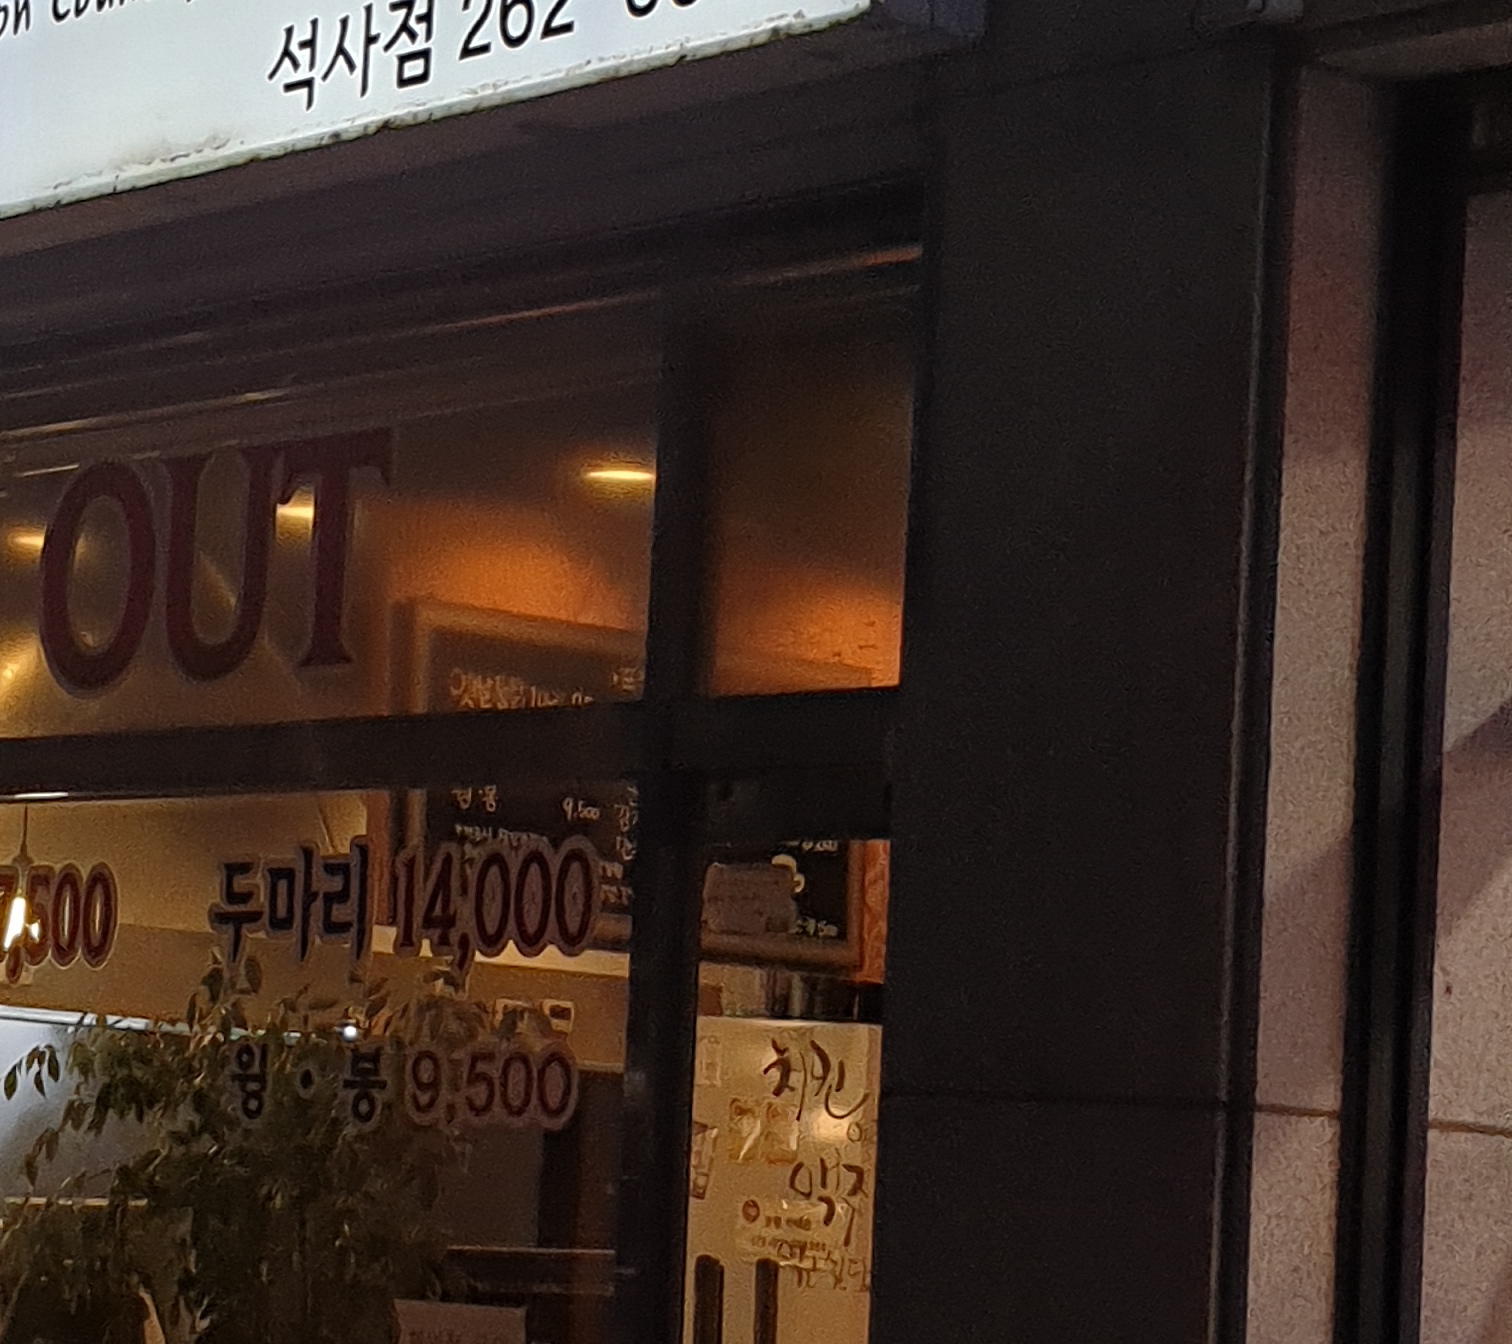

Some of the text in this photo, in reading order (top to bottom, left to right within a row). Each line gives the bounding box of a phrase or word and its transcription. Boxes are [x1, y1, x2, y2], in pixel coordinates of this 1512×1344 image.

[38, 428, 394, 699] OUT
[210, 836, 600, 976] 두마리 14,000
[407, 1047, 577, 1130] 9,500
